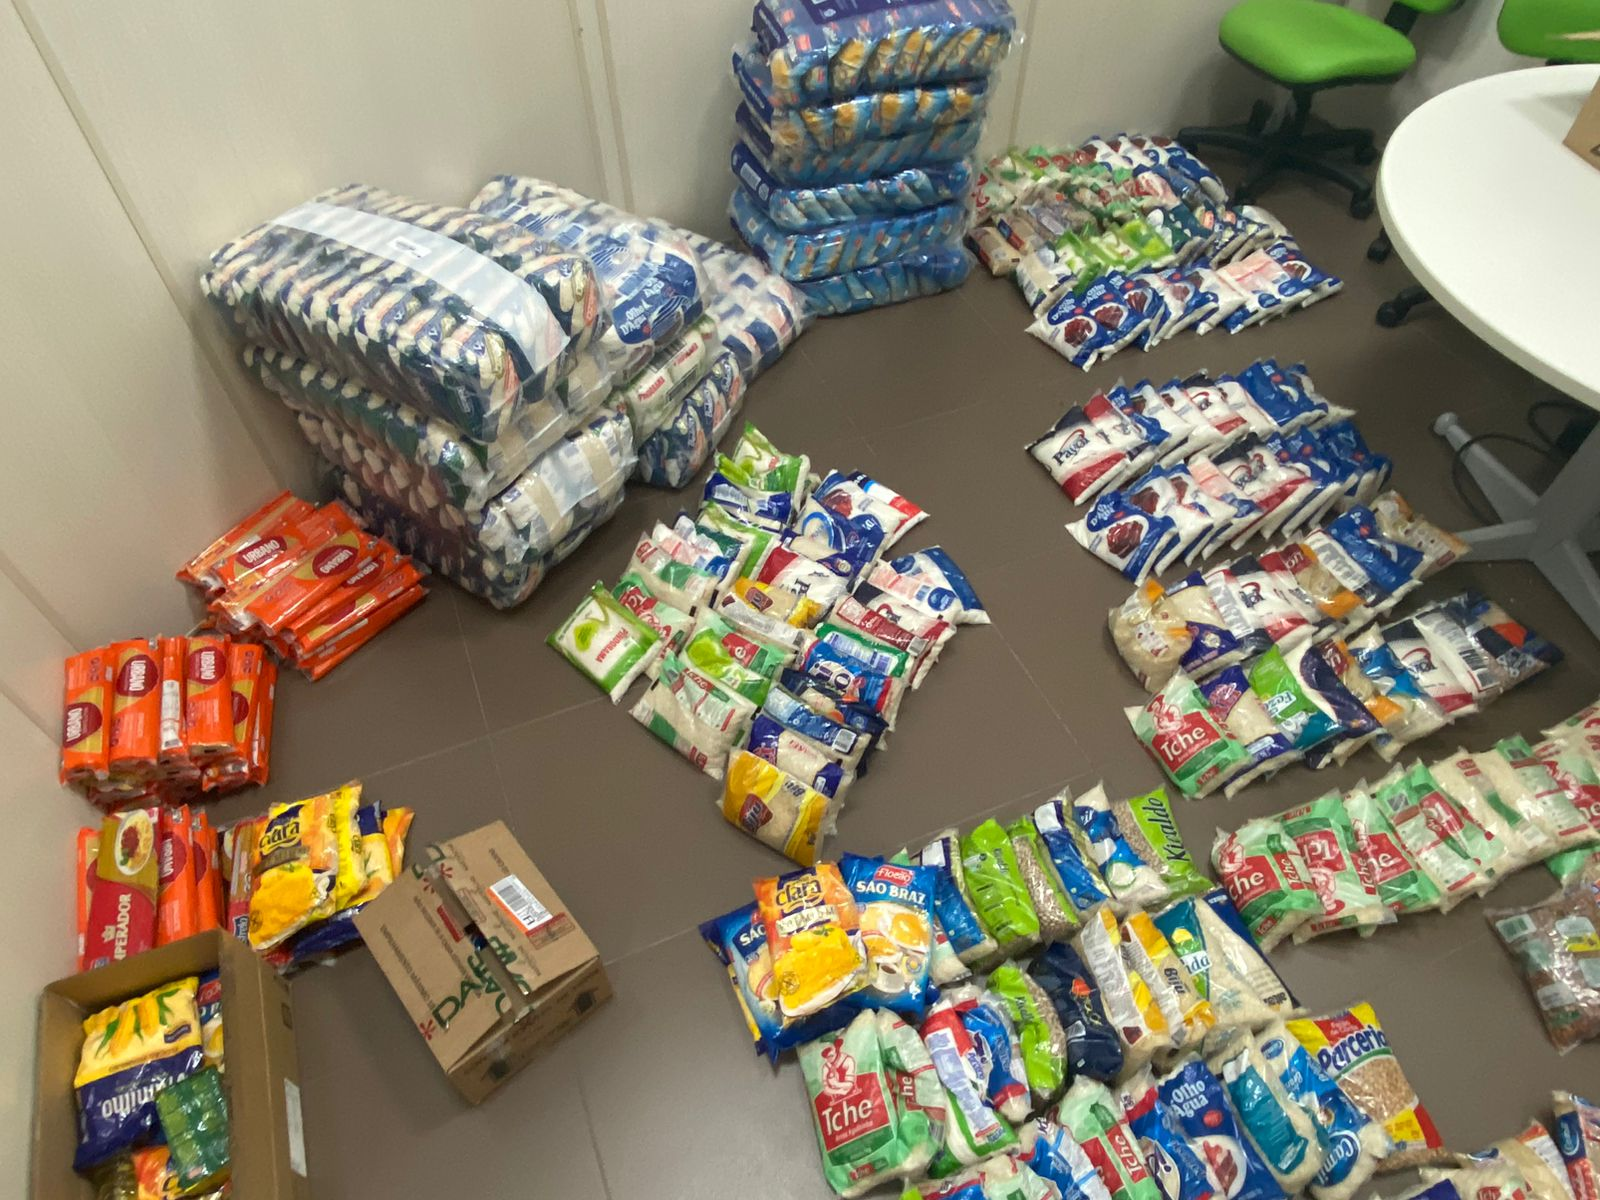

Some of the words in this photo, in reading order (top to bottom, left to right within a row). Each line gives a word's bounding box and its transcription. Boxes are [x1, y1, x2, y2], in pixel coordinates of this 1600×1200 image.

[242, 539, 280, 564] URBANO
[319, 549, 354, 575] URBANO
[128, 659, 146, 692] URBANO
[199, 651, 216, 681] URBANO
[1160, 726, 1207, 762] Tche
[1144, 797, 1192, 863] Kicaldo
[775, 880, 822, 906] Clara
[888, 885, 926, 906] BRAZ
[1228, 871, 1265, 902] che
[113, 893, 132, 960] PERADOR
[1171, 1080, 1206, 1102] Olho
[822, 1098, 873, 1136] Tche
[1318, 1137, 1355, 1186] Camil
